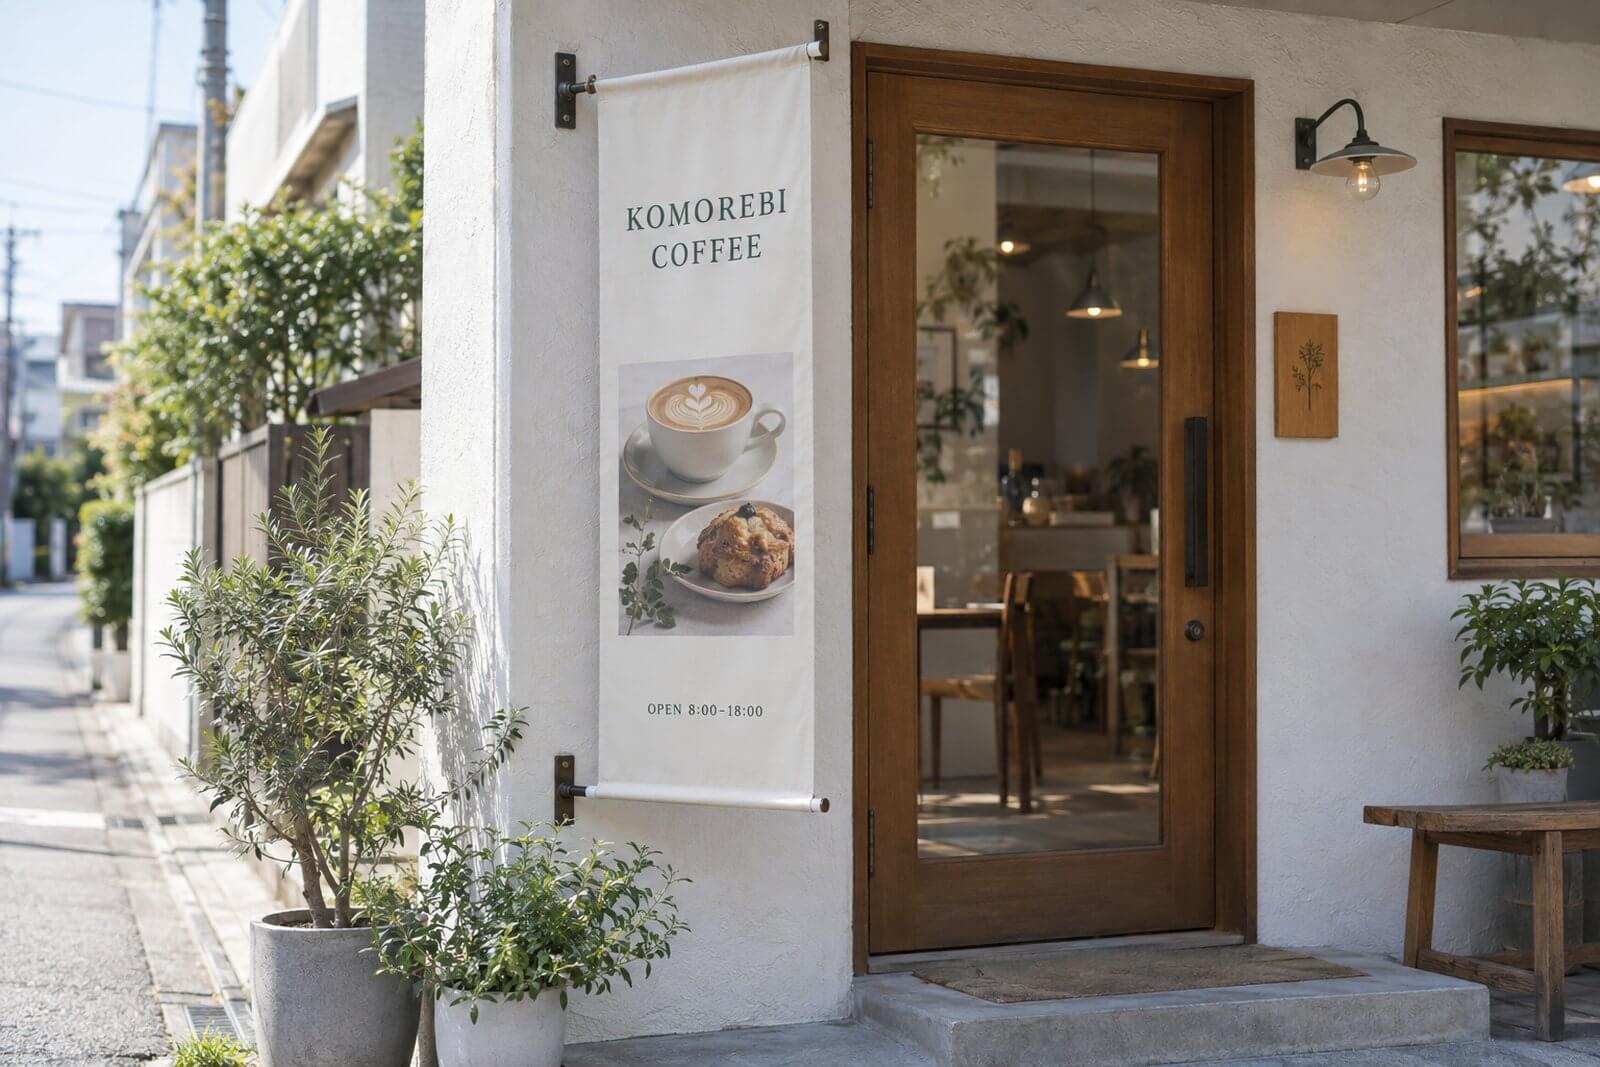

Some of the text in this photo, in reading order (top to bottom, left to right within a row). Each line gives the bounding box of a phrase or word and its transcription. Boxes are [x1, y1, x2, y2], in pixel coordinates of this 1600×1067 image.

[626, 188, 786, 231] KOMOREBI
[651, 233, 762, 269] COFFEE
[647, 703, 682, 716] OPEN
